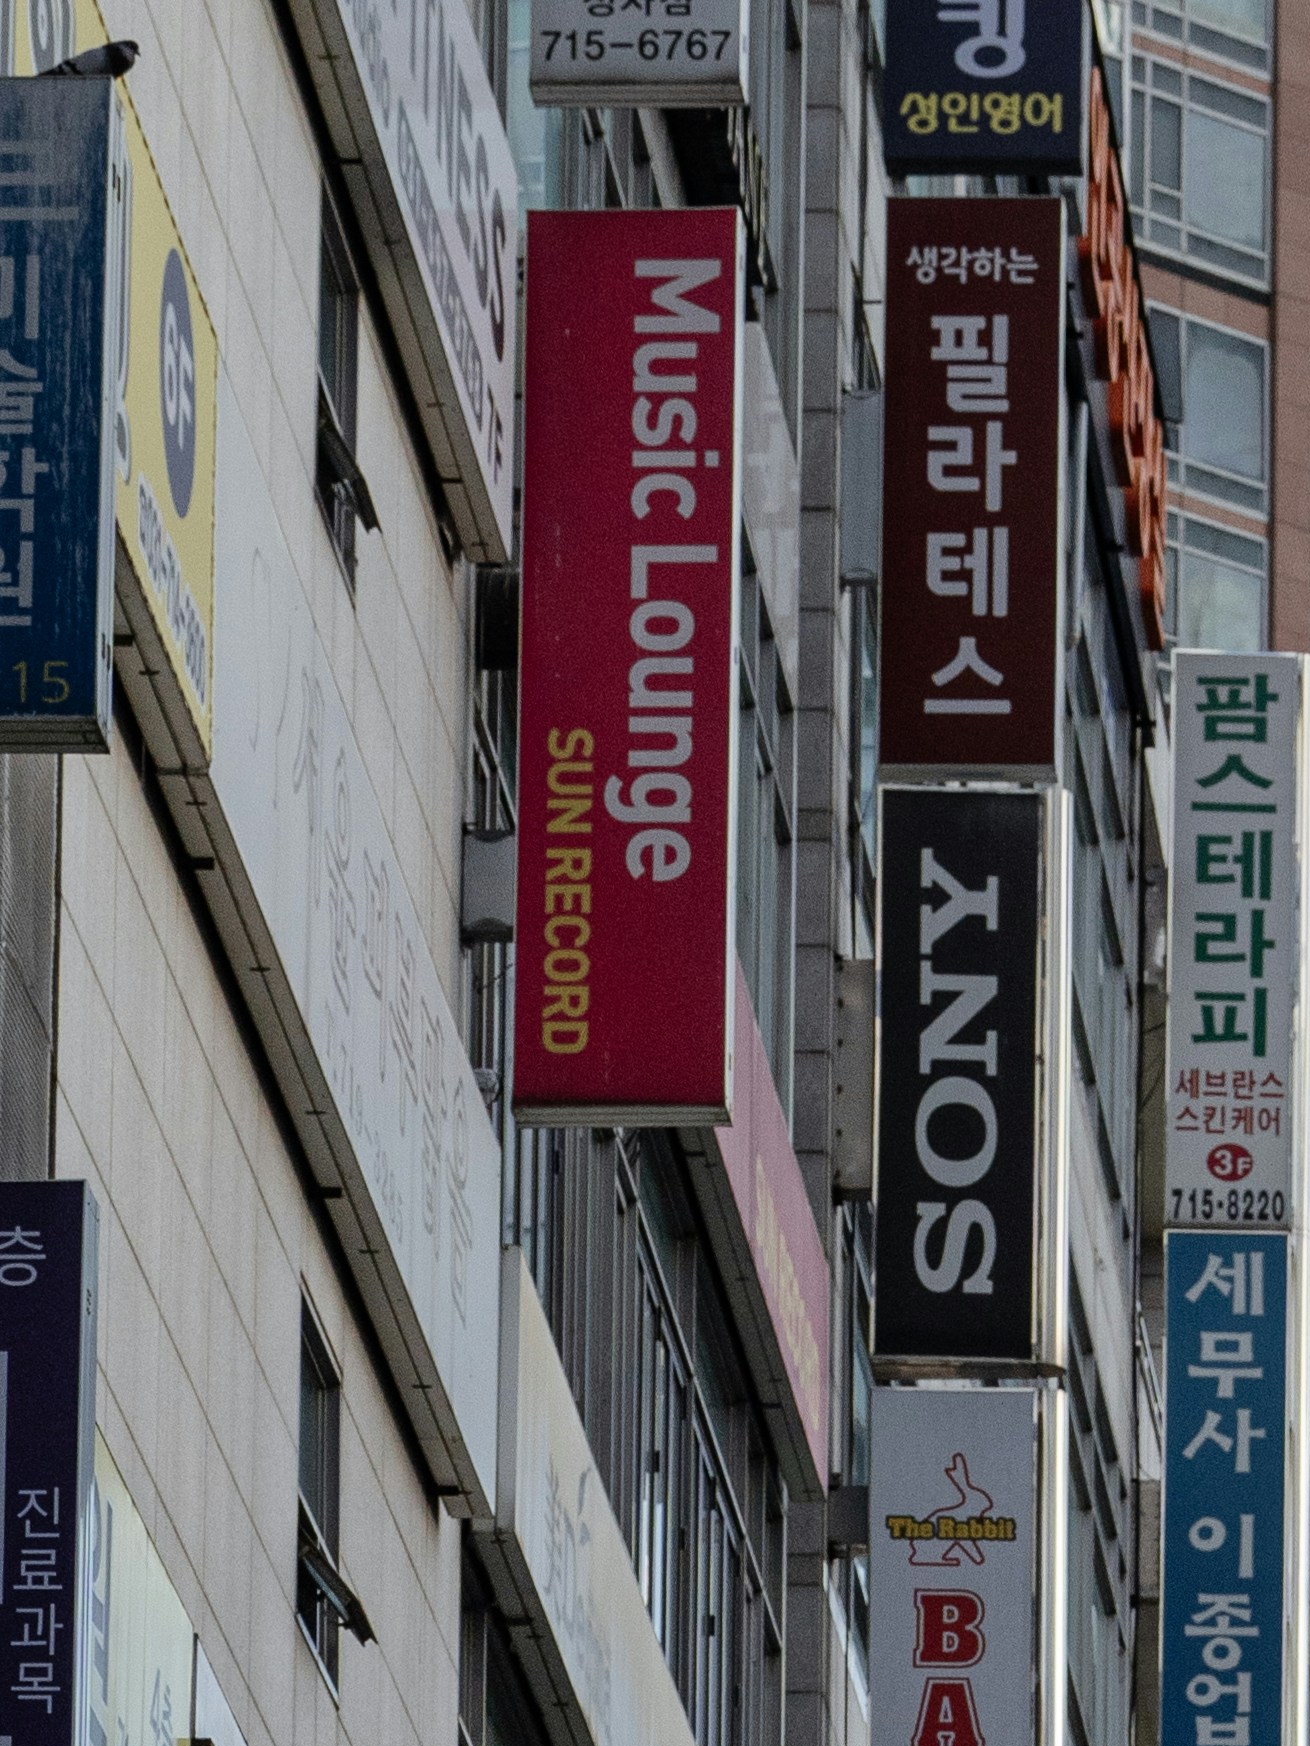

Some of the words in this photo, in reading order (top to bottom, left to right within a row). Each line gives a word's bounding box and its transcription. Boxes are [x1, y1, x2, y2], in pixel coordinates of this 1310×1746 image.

[541, 30, 732, 63] 715-6767
[900, 91, 1064, 136] 성인영어
[905, 245, 1041, 285] 생각하는
[628, 257, 722, 522] Music
[922, 313, 1017, 716] 필라테스
[547, 728, 593, 834] SUN
[604, 543, 718, 882] Lounge
[1192, 673, 1278, 1058] 팜스테라피
[541, 846, 592, 1054] RECORD
[913, 848, 999, 1294] SONY
[1176, 1069, 1285, 1100] 세브란스
[1176, 1103, 1282, 1137] 스킨케어
[1212, 1150, 1252, 1177] 3F
[1181, 1249, 1266, 1475] 세무사
[9, 1486, 63, 1714] 진료과목
[887, 1517, 934, 1541] The
[937, 1515, 1016, 1541] Rabbit
